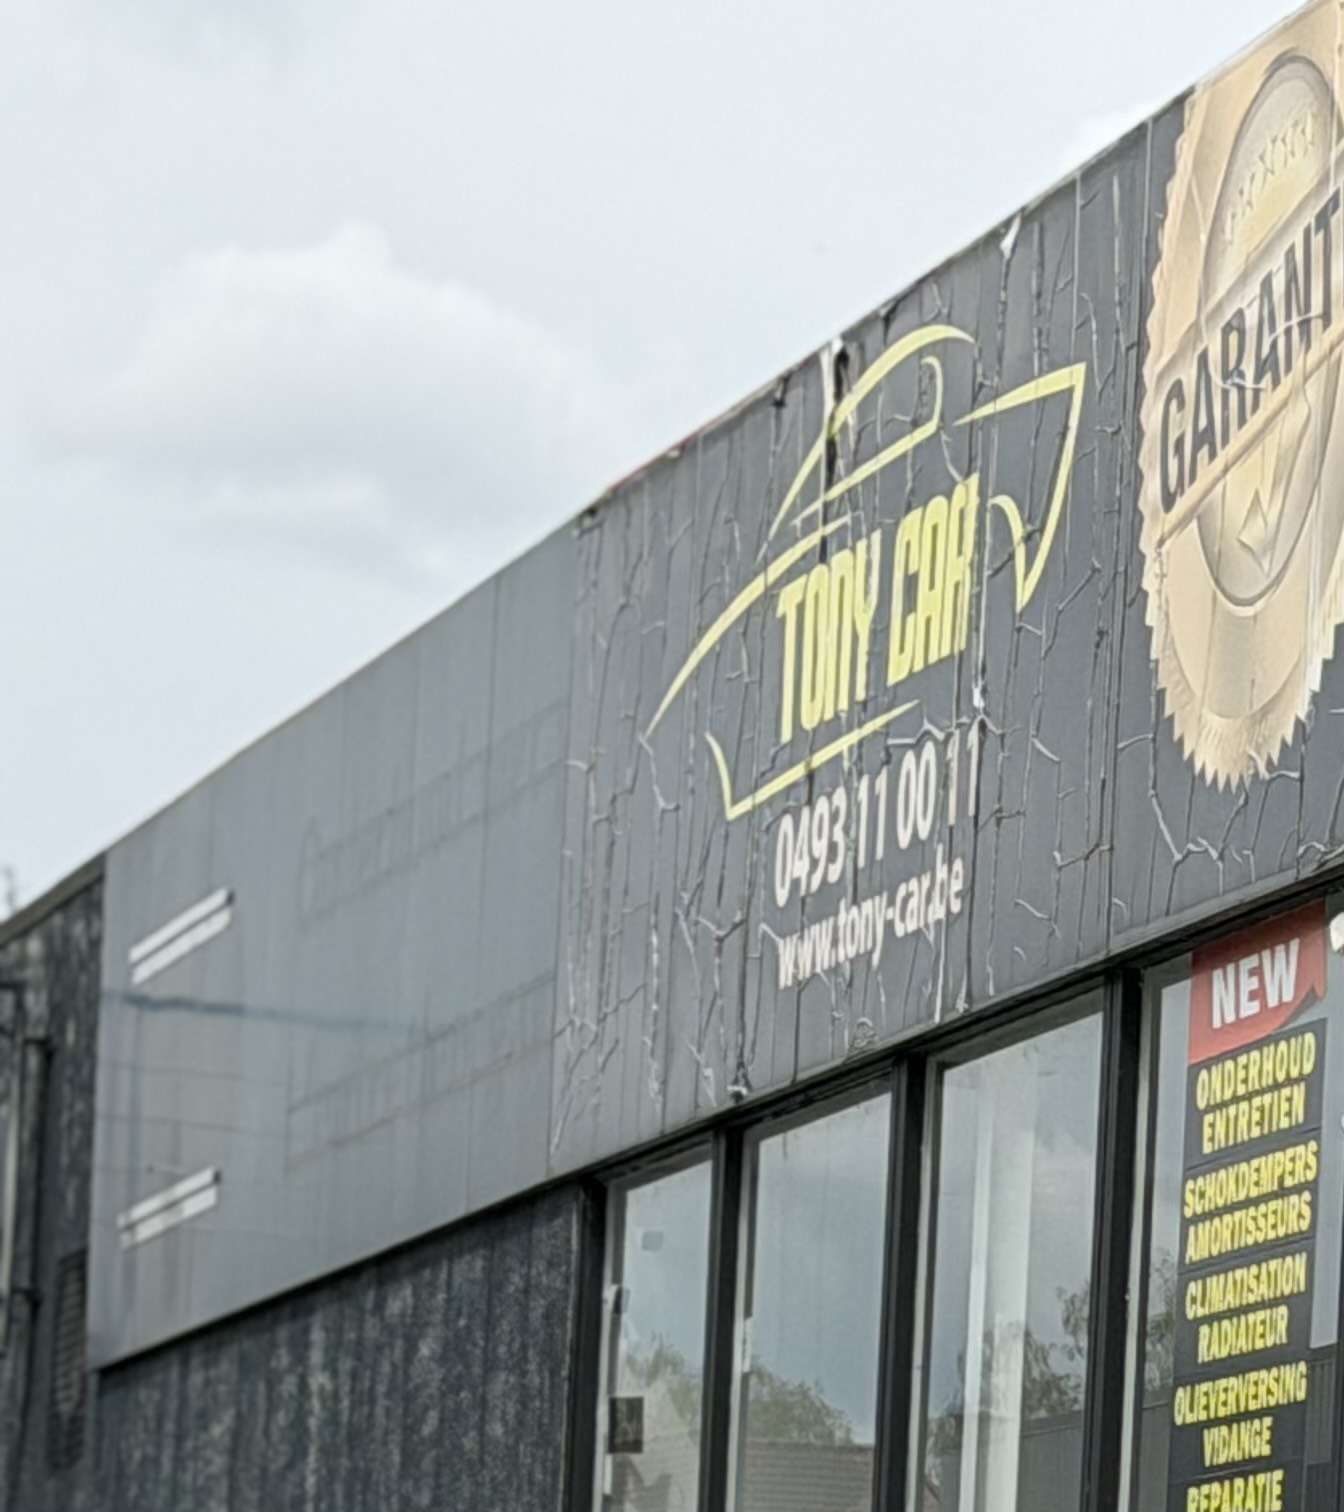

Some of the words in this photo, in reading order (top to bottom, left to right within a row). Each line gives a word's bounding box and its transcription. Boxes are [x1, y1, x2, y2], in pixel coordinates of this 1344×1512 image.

[777, 529, 881, 744] TONY
[887, 472, 980, 686] CAR
[775, 786, 847, 908] 0493
[858, 765, 887, 869] 11
[897, 741, 936, 850] 00
[946, 722, 979, 826] 11
[779, 843, 964, 990] www.tony-car.be
[1212, 938, 1300, 1029] NEW
[1196, 1031, 1316, 1110] ONDERHOUD
[1202, 1082, 1305, 1155] ENTRETIEN
[1184, 1140, 1318, 1218] SCHOKDEMPERS
[1185, 1190, 1312, 1264] AMORTISSEURS
[1185, 1251, 1307, 1320] CLIMATISATION
[1198, 1304, 1288, 1364] RADIATEUR
[1174, 1360, 1307, 1426] OLIEVERVERSING
[1203, 1416, 1273, 1467] VIDANGE
